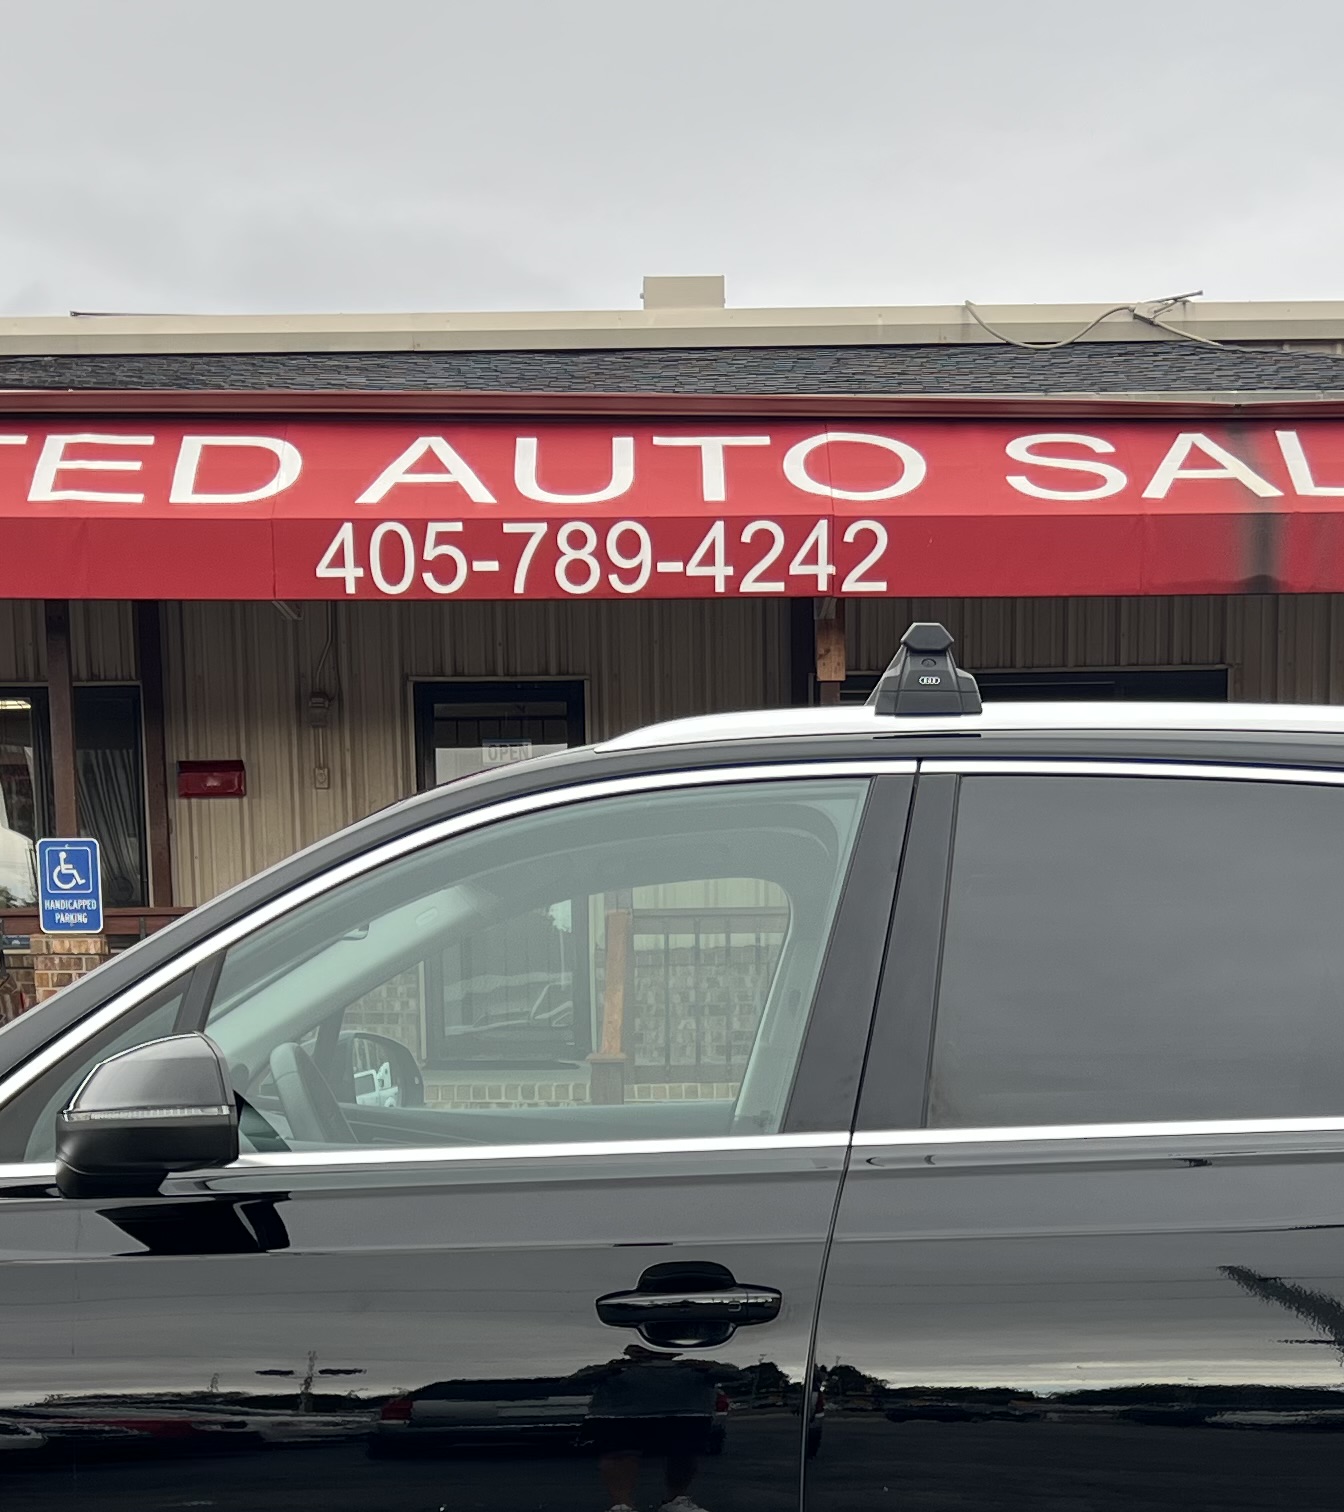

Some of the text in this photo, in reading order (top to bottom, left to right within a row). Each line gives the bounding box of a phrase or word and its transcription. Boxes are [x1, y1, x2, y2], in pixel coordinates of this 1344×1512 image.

[354, 434, 927, 504] AUTO
[315, 519, 889, 596] 405-789-4242
[44, 899, 97, 911] HANDICAPPED
[55, 911, 89, 924] PARKING
